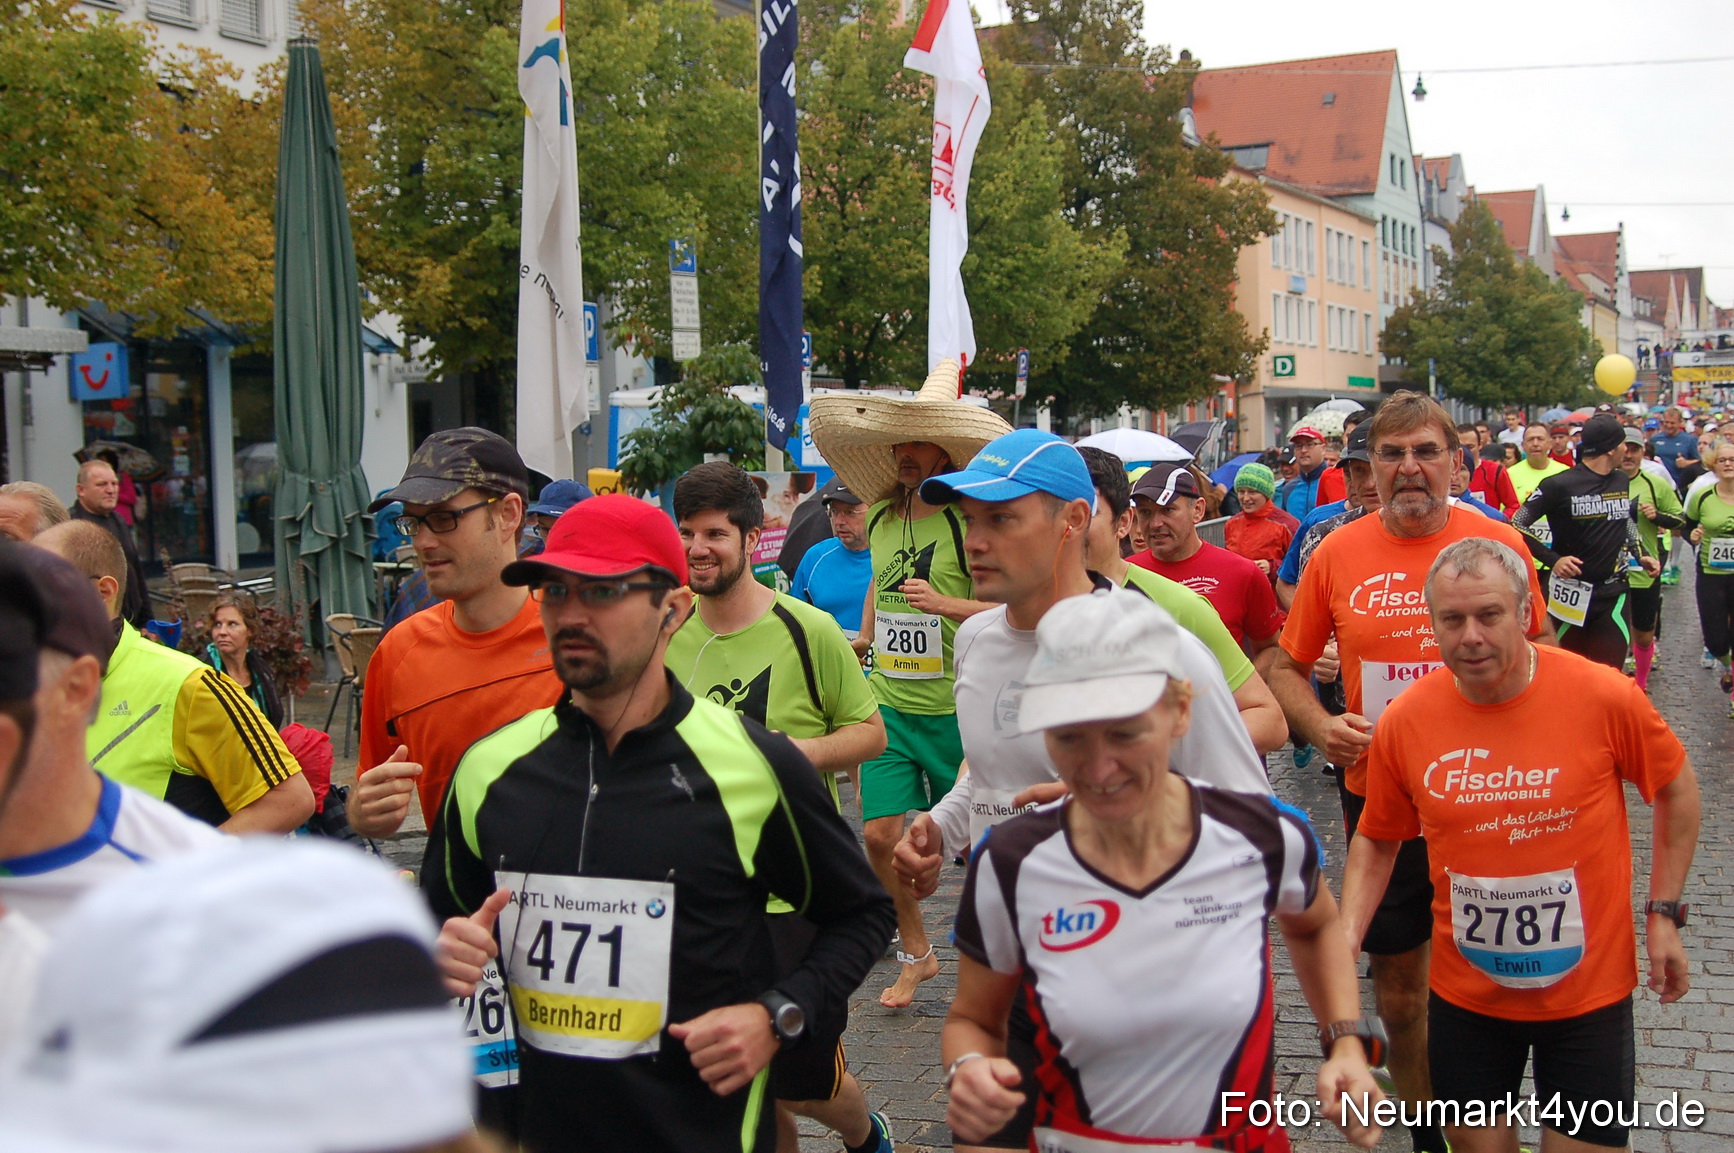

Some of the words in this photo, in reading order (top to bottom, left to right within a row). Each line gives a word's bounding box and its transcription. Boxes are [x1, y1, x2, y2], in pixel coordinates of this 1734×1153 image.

[584, 310, 595, 354] P
[1276, 357, 1293, 374] D
[1553, 585, 1580, 606] 550
[877, 616, 893, 626] PARTL
[895, 619, 928, 627] Neumarkt
[887, 628, 927, 655] 280
[893, 659, 919, 670] Armin
[1445, 765, 1560, 792] Fischer
[1455, 788, 1551, 804] AUTOMOBILE
[1502, 813, 1526, 827] das
[1508, 827, 1543, 845] fährt
[1184, 895, 1213, 905] team
[1453, 883, 1488, 900] PARTL
[1490, 885, 1553, 900] Neumarkt
[508, 890, 549, 909] ARTL
[554, 895, 637, 915] Neumarkt
[1193, 901, 1242, 915] klinikum
[1041, 907, 1096, 935] tkn
[1175, 915, 1228, 928] nürnberg
[1463, 901, 1566, 946] 2787
[527, 920, 623, 988] 471
[1494, 957, 1542, 973] Erwin
[529, 998, 622, 1032] Bernhard
